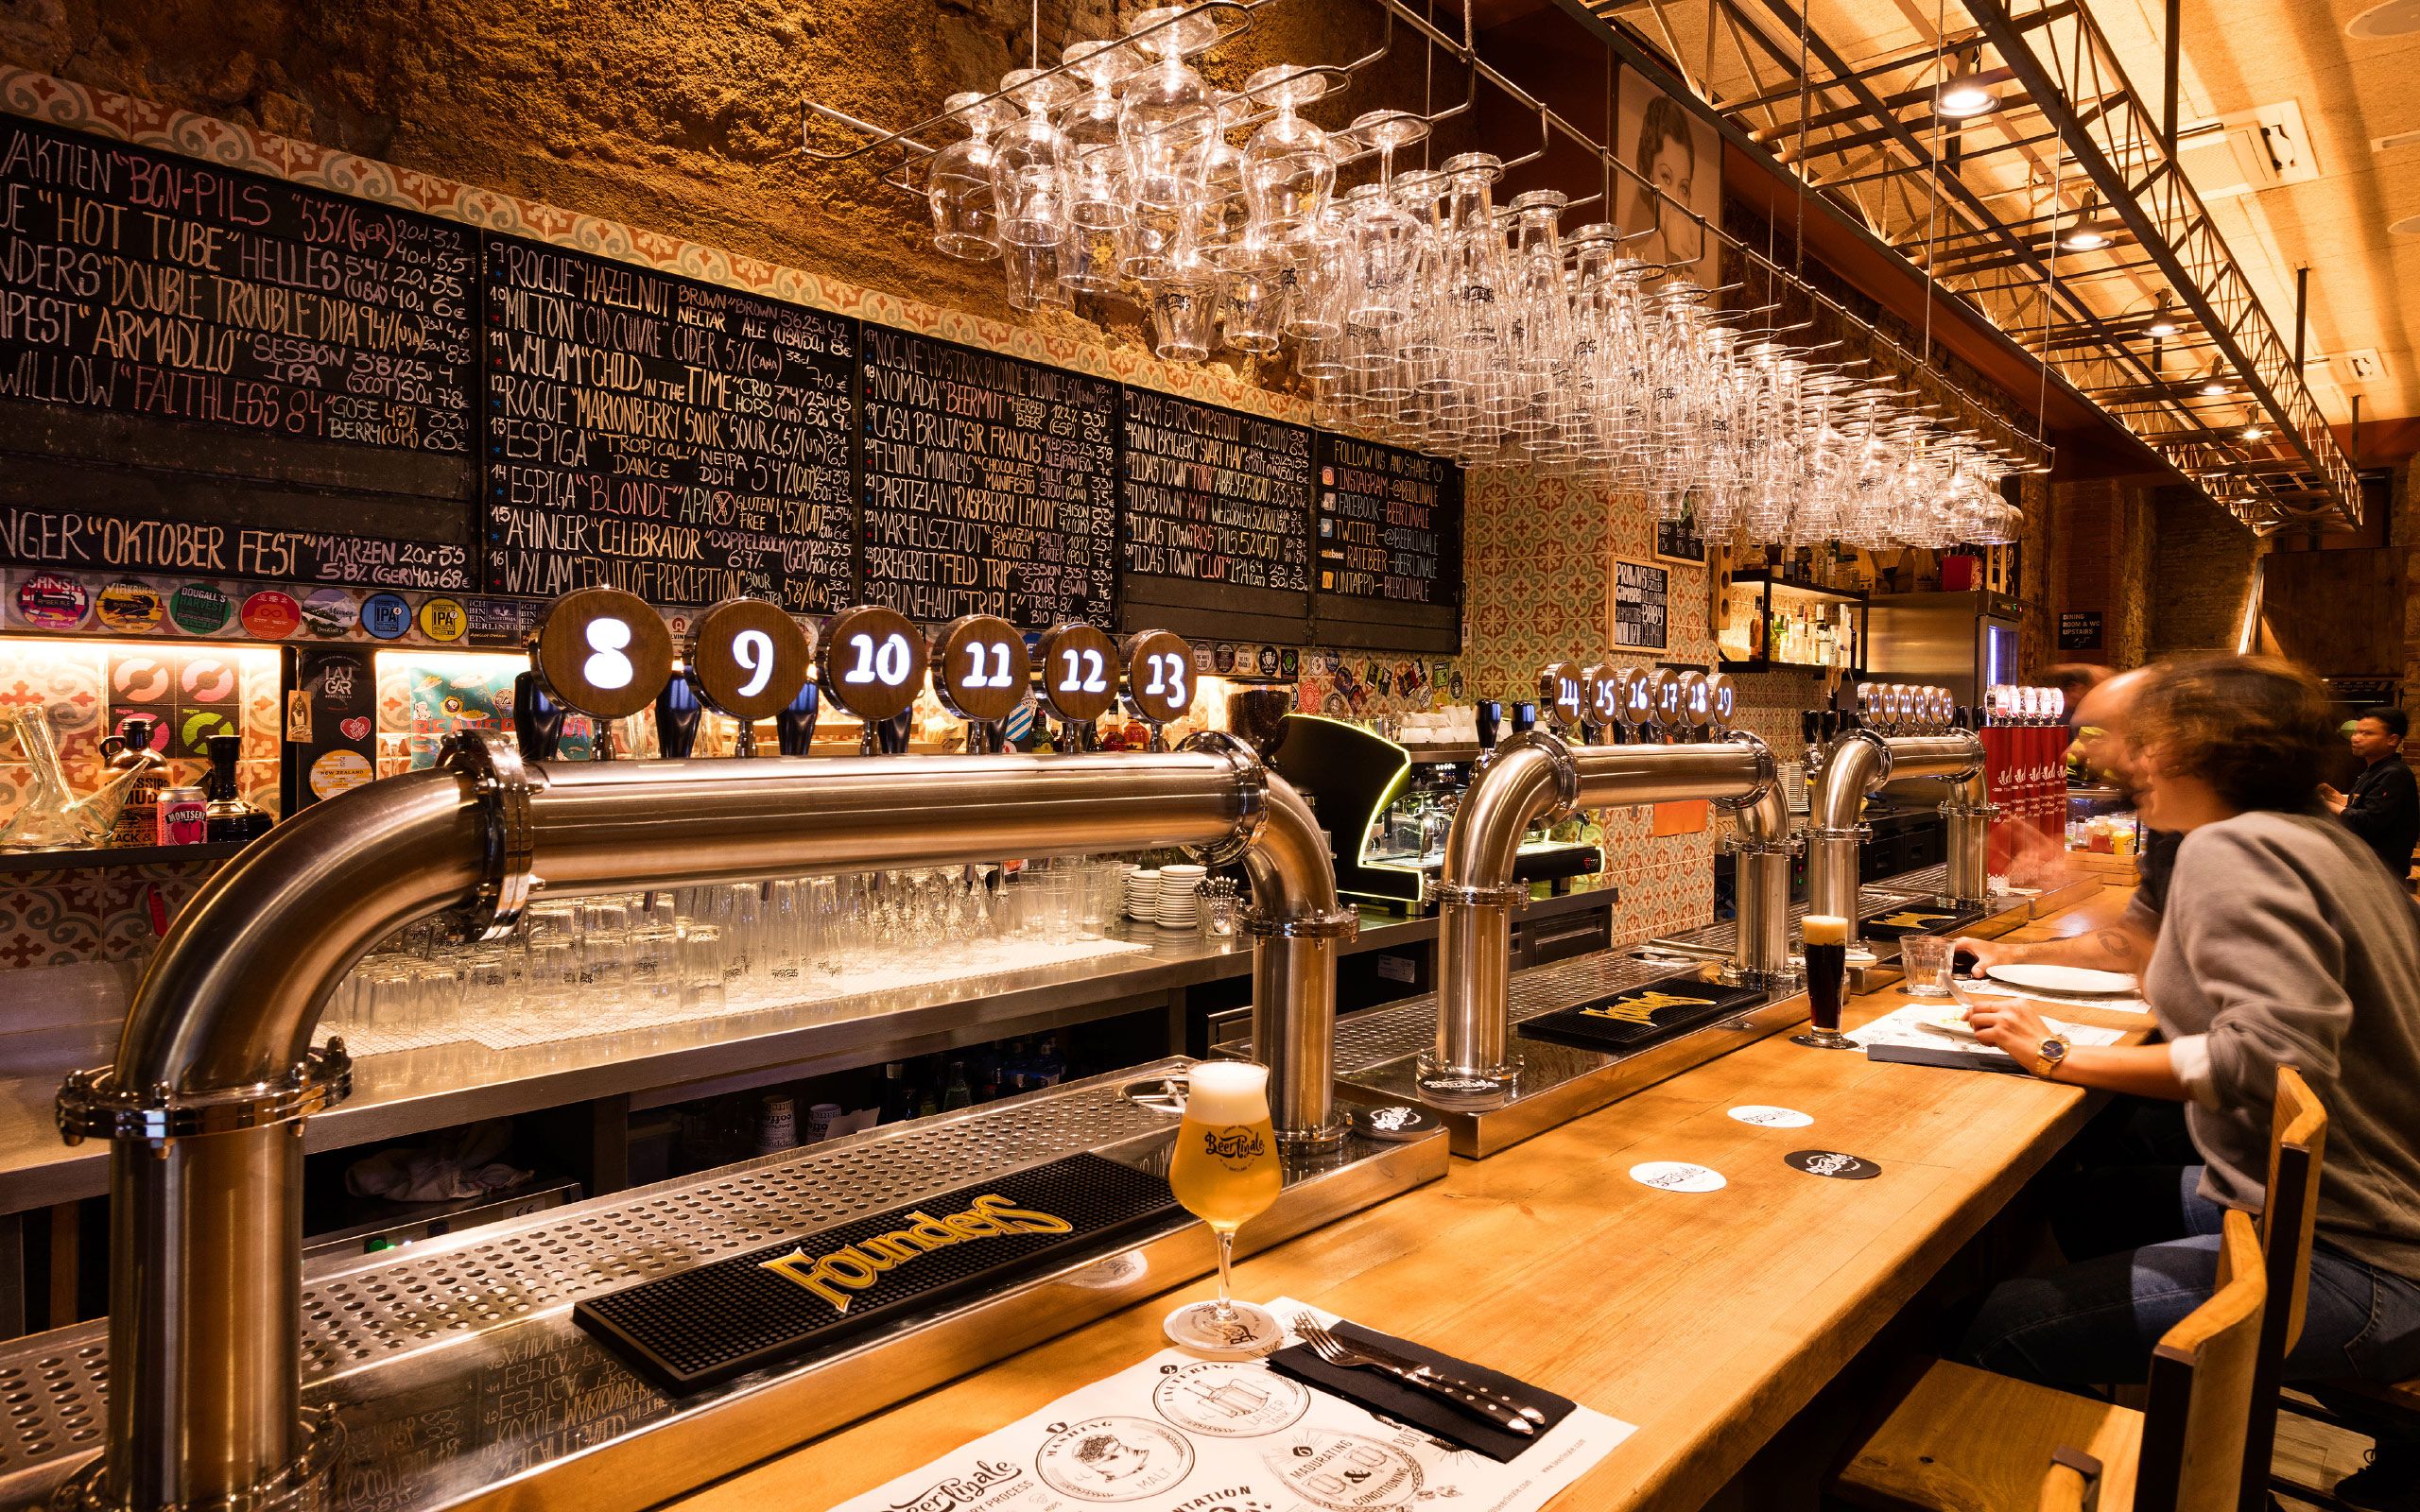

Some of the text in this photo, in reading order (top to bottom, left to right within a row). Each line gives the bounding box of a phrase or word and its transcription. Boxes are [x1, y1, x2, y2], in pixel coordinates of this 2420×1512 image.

[241, 233, 341, 291] HELLES
[507, 246, 575, 297] ROGUE
[735, 300, 778, 319] BROWN
[320, 296, 359, 348] DIPA
[490, 285, 506, 301] 10
[505, 286, 575, 341] MILTON
[672, 325, 719, 369] CIDER
[677, 305, 767, 338] NECTAR ALE
[253, 334, 345, 367] SESSION
[264, 361, 321, 387] IPA
[490, 331, 503, 347] 11
[504, 333, 581, 385] WYLAM
[644, 378, 657, 397] IN
[660, 380, 685, 403] THE
[332, 396, 381, 420] GOSE
[735, 394, 773, 418] HOPS
[875, 368, 940, 410] NOMADA
[1011, 395, 1046, 418] HERBED
[492, 374, 506, 393] 12
[506, 375, 567, 424] ROGUE
[730, 415, 769, 454] SOUR
[874, 404, 1062, 452] CASA BRUJA RED
[1015, 413, 1043, 429] BEER
[1130, 391, 1194, 435] DARK STAR
[328, 418, 380, 444] BERRY
[491, 417, 748, 471] 13 ESPIGA NEIPA
[1131, 423, 1155, 452] KINN
[613, 455, 735, 486] DANCE DDH
[874, 439, 1062, 484] FLYING MONKEYS MILK
[1045, 452, 1060, 467] ALE
[1161, 457, 1187, 488] TOWN
[1335, 440, 1430, 481] FOLLOW US AND SHARE
[491, 464, 507, 480] 14
[511, 466, 576, 510] ESPIGA
[680, 487, 712, 525] APA
[736, 495, 774, 513] GLUTEN
[875, 474, 951, 515] PARTIZAN
[1059, 502, 1089, 518] SAISON
[985, 472, 1064, 500] MANIFESTO STOUT
[1159, 488, 1183, 516] TOWN
[492, 507, 510, 522] 15
[739, 513, 767, 531] FREE
[1040, 532, 1064, 548] BALTIC
[1165, 521, 1237, 555] TOWN PILS
[873, 547, 1061, 582] BREKERIET SESSION
[1039, 547, 1064, 562] PORTER
[1167, 548, 1248, 585] TOWN IPA
[490, 551, 504, 566] 16
[506, 551, 574, 595] WYLAM
[631, 561, 654, 599] OF
[745, 571, 771, 590] SOUR
[1021, 576, 1057, 595] SOUR
[1616, 563, 1648, 589] PRAWNS
[179, 598, 225, 613] HARVEST
[1026, 594, 1058, 610] TRIPEL
[1616, 586, 1641, 603] GAMBAS
[376, 608, 396, 622] IPA
[433, 611, 454, 625] IPA
[469, 614, 486, 623] EIN
[469, 623, 520, 631] BERLINER
[1641, 605, 1664, 625] BABY
[584, 618, 633, 689] 8
[733, 630, 774, 697] 9
[845, 633, 912, 686] 10
[961, 642, 1012, 688] 11
[1060, 649, 1107, 692] 12
[1146, 653, 1185, 709] 13
[325, 679, 352, 696] GAR
[1558, 677, 1580, 716] 14
[1596, 679, 1615, 715] 15
[1629, 677, 1649, 709] 16
[1661, 683, 1678, 713] 17
[1689, 682, 1706, 713] 18
[1718, 687, 1732, 716] 19
[758, 1194, 1073, 1314] Founders
[1046, 1420, 1113, 1457] MASHING
[1289, 1439, 1354, 1480] MADURATING
[1135, 1465, 1173, 1489] MALT
[1343, 1467, 1372, 1486] &
[1353, 1467, 1410, 1507] CONDITIONING
[986, 1480, 1034, 1510] PROCESS
